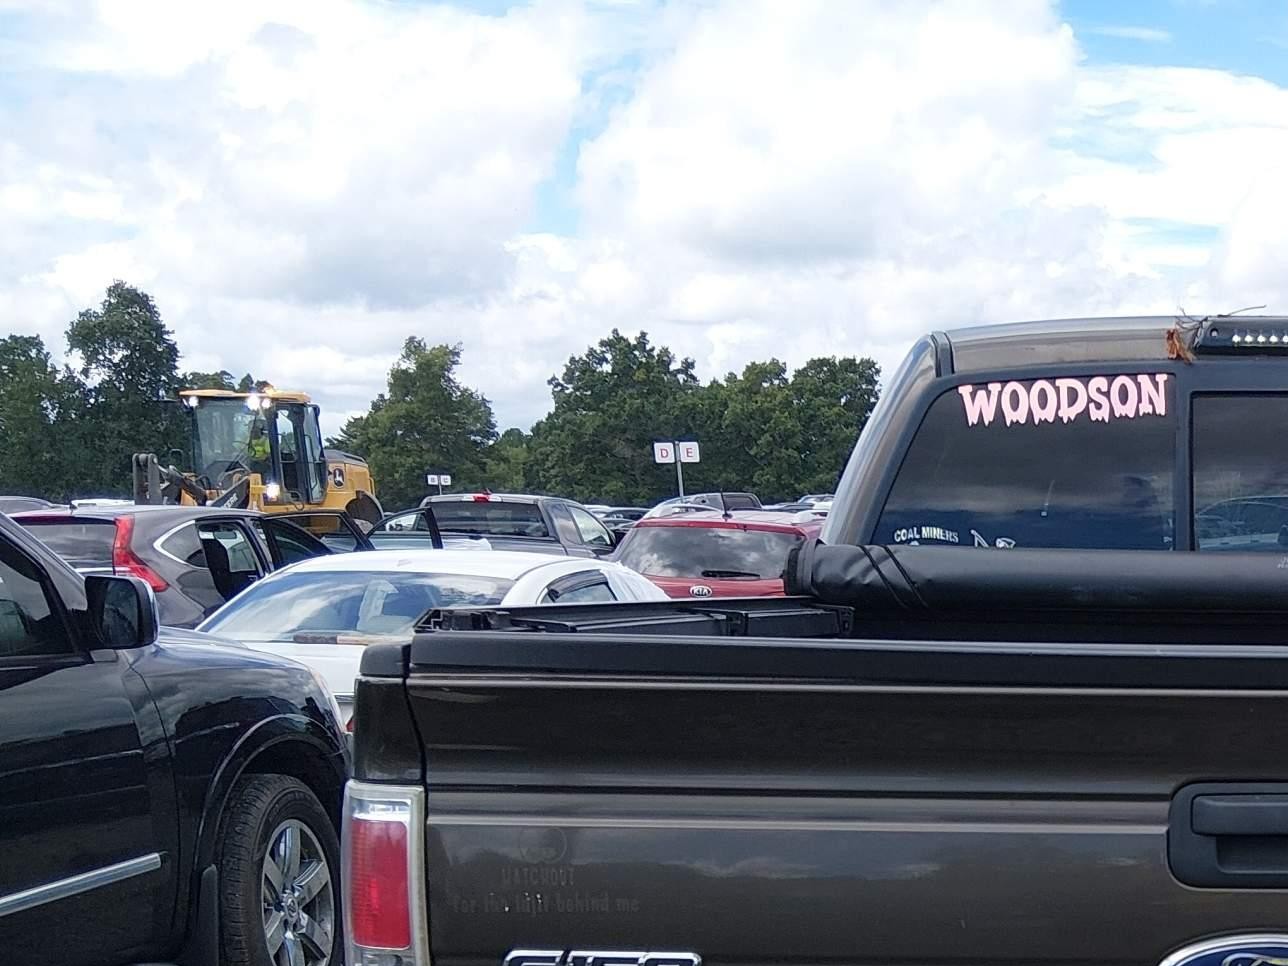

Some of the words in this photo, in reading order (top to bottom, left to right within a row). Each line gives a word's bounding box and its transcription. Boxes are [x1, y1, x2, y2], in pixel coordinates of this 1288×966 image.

[958, 373, 1168, 427] WOODSON
[660, 448, 669, 458] D
[686, 448, 693, 458] E
[894, 527, 920, 542] COAL
[921, 526, 959, 543] MINERS
